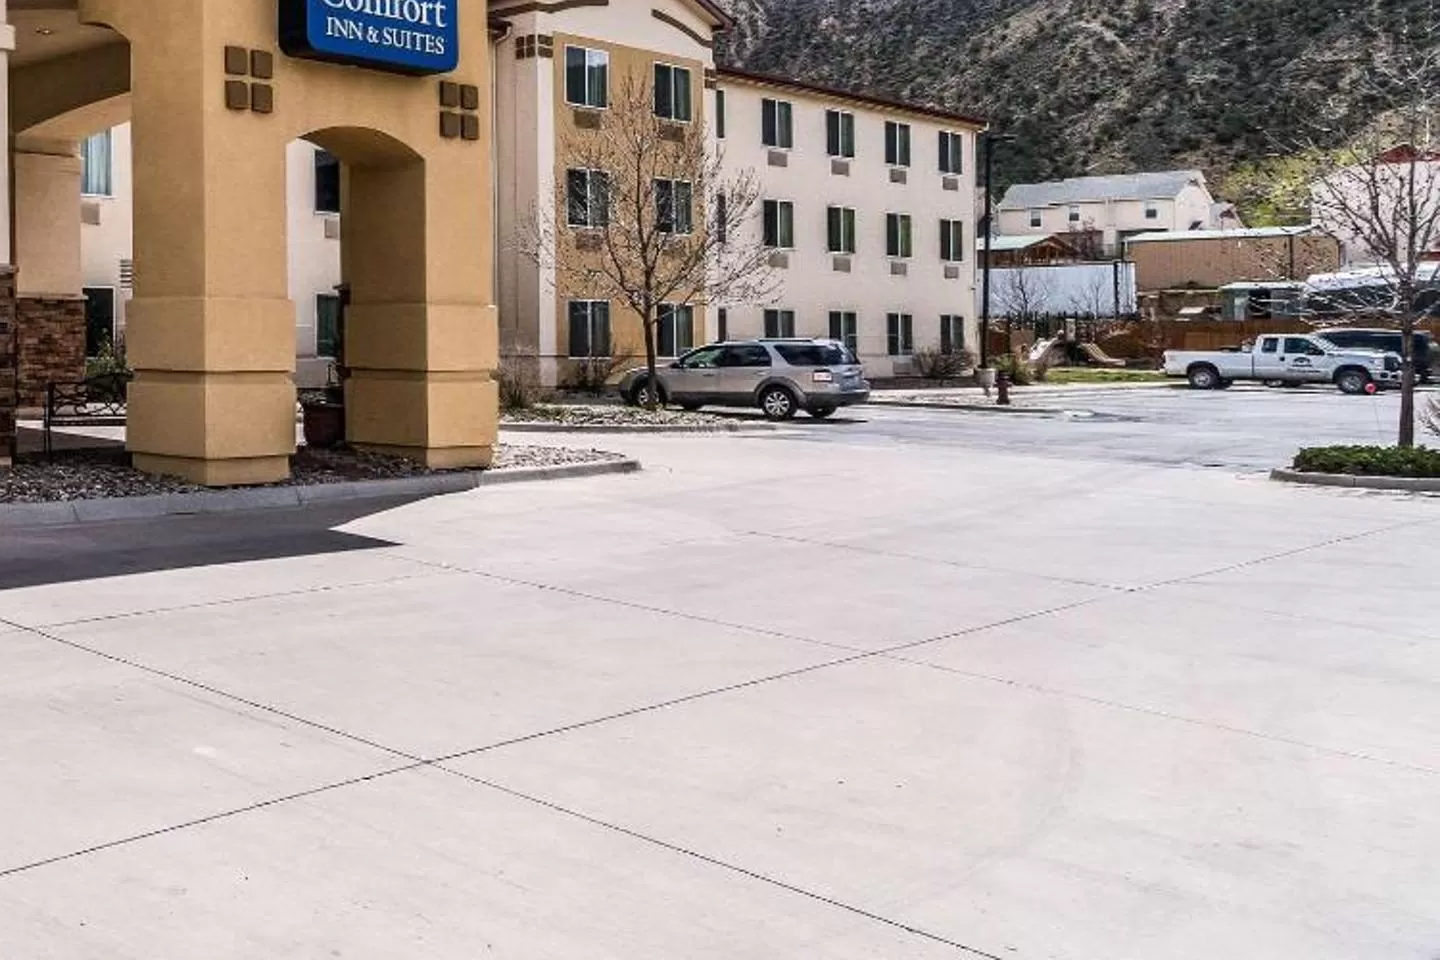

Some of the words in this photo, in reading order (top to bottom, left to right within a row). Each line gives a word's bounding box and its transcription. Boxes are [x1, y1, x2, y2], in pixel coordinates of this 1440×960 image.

[326, 16, 364, 41] INN
[366, 25, 380, 44] &
[382, 27, 445, 55] SUITES
